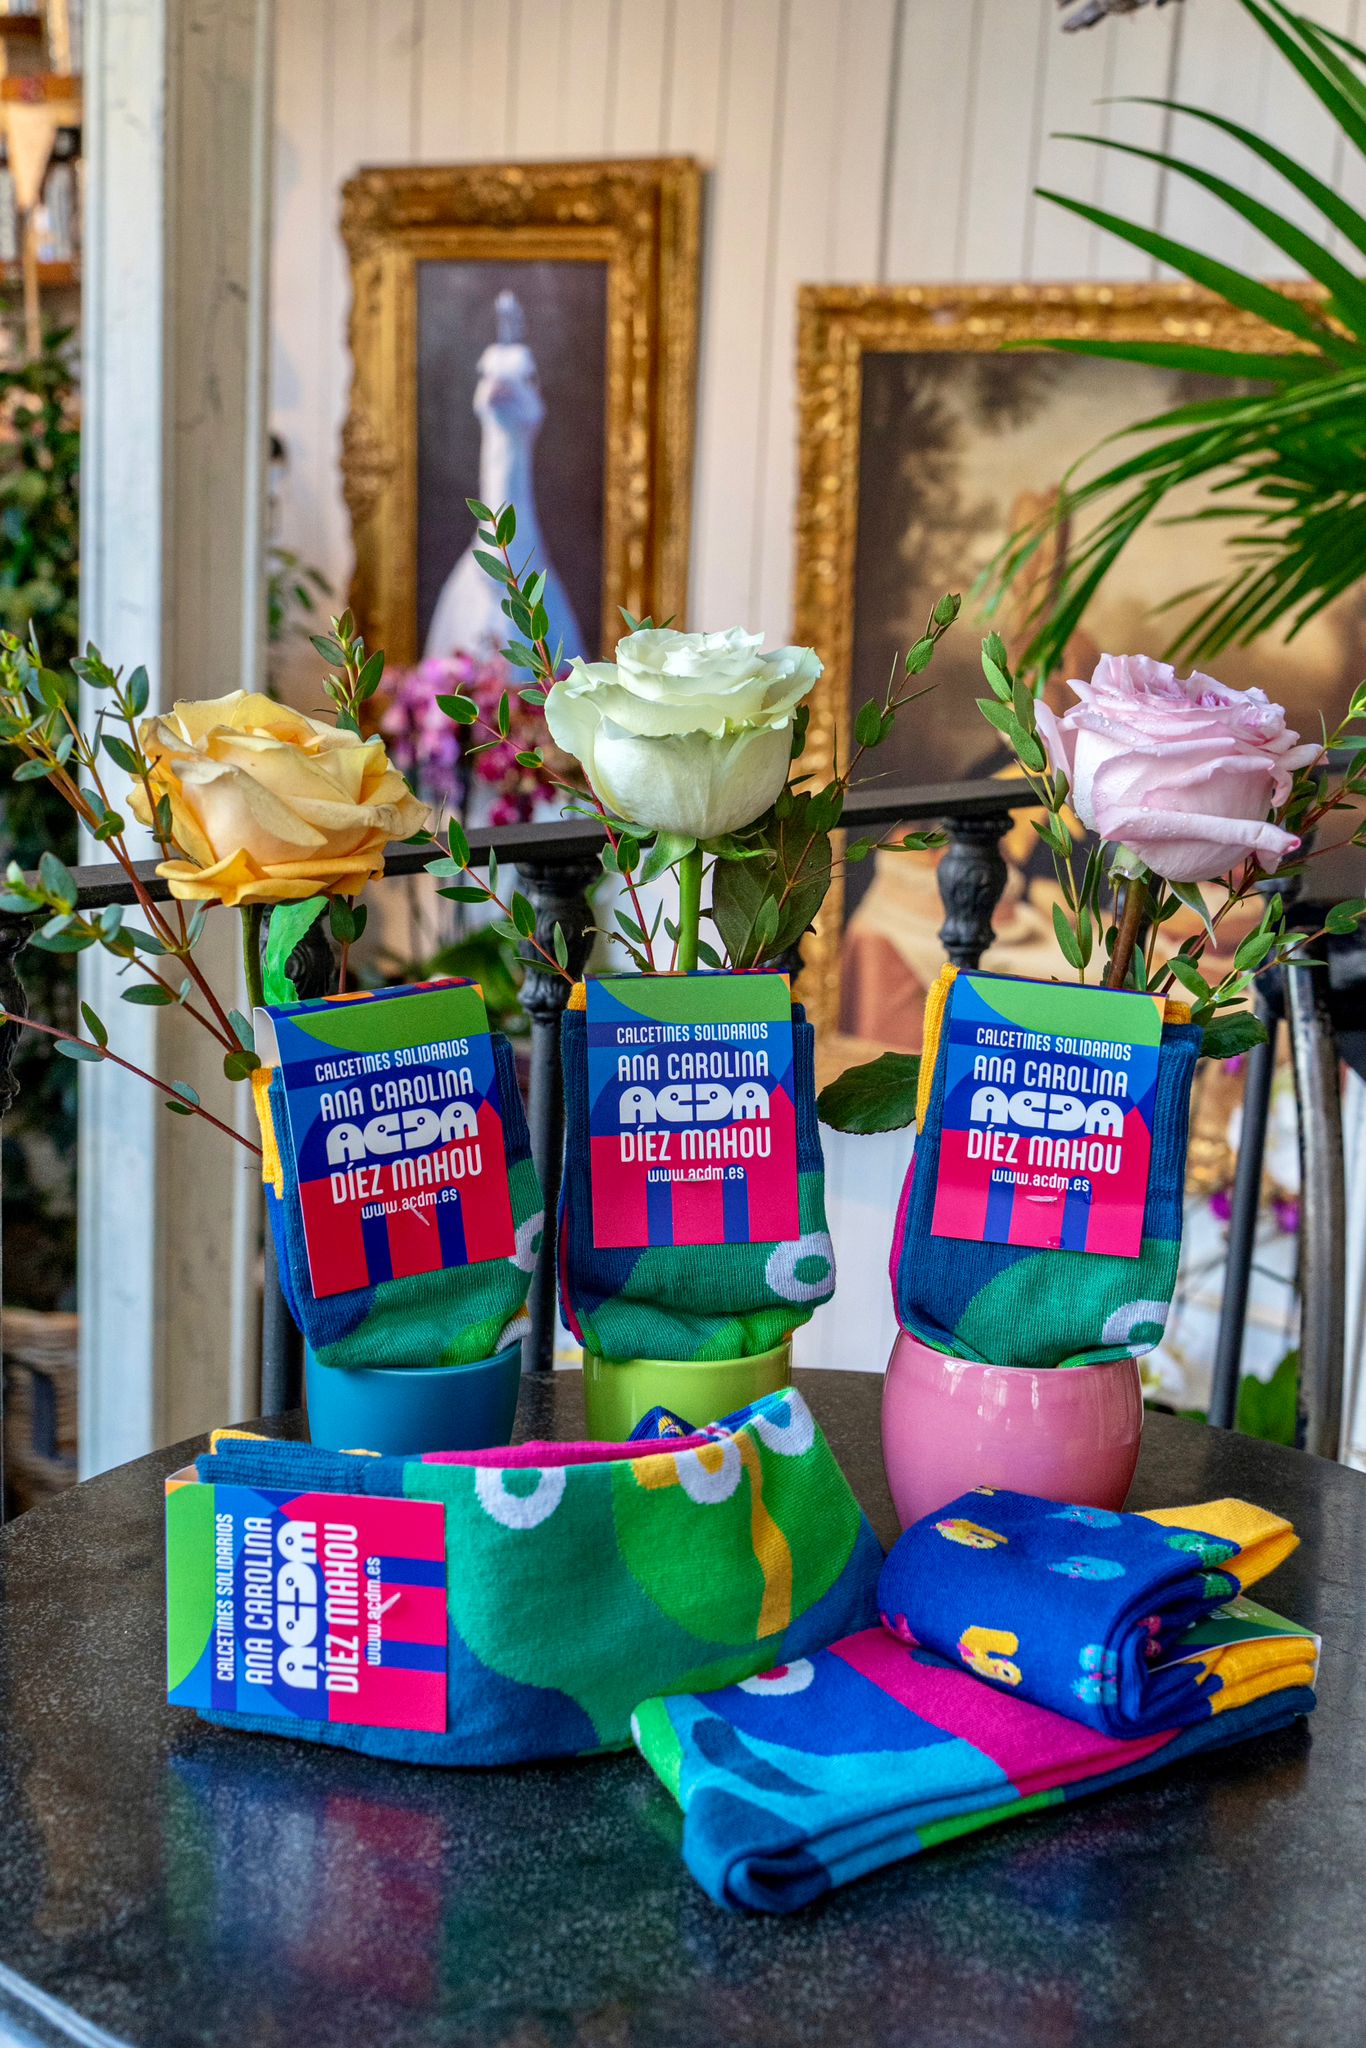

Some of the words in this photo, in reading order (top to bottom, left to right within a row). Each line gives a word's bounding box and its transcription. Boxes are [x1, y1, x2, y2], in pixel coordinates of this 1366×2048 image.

[616, 1025, 690, 1044] CALCETINES
[694, 1023, 768, 1041] SOLIDARIOS
[976, 1028, 1051, 1052] CALCETINES
[1055, 1037, 1132, 1061] SOLIDARIOS
[315, 1051, 391, 1082] CALCETINES
[395, 1039, 469, 1067] SOLIDARIOS
[617, 1054, 660, 1082] ANA
[667, 1050, 769, 1080] CAROLINA
[973, 1055, 1016, 1085] ANA
[1023, 1060, 1128, 1097] CAROLINA
[320, 1087, 365, 1122] ANA
[370, 1067, 474, 1112] CAROLINA
[620, 1124, 672, 1163] DÍEZ
[681, 1126, 771, 1161] MAHOU
[966, 1124, 1021, 1164] DÍEZ
[1028, 1135, 1122, 1174] MAHOU
[330, 1161, 384, 1205] DÍEZ
[391, 1144, 482, 1191] MAHOU
[991, 1168, 1090, 1192] www.acdm.es
[361, 1188, 457, 1219] www.acdm.es
[215, 1513, 234, 1596] SOLIDARIOS
[243, 1516, 273, 1631] CAROLINA
[324, 1523, 359, 1626] MAHOU
[364, 1556, 382, 1666] www.acdm.es
[216, 1599, 235, 1681] CALCETINES
[245, 1638, 273, 1685] ANA
[318, 1633, 359, 1693] DÍEZ
